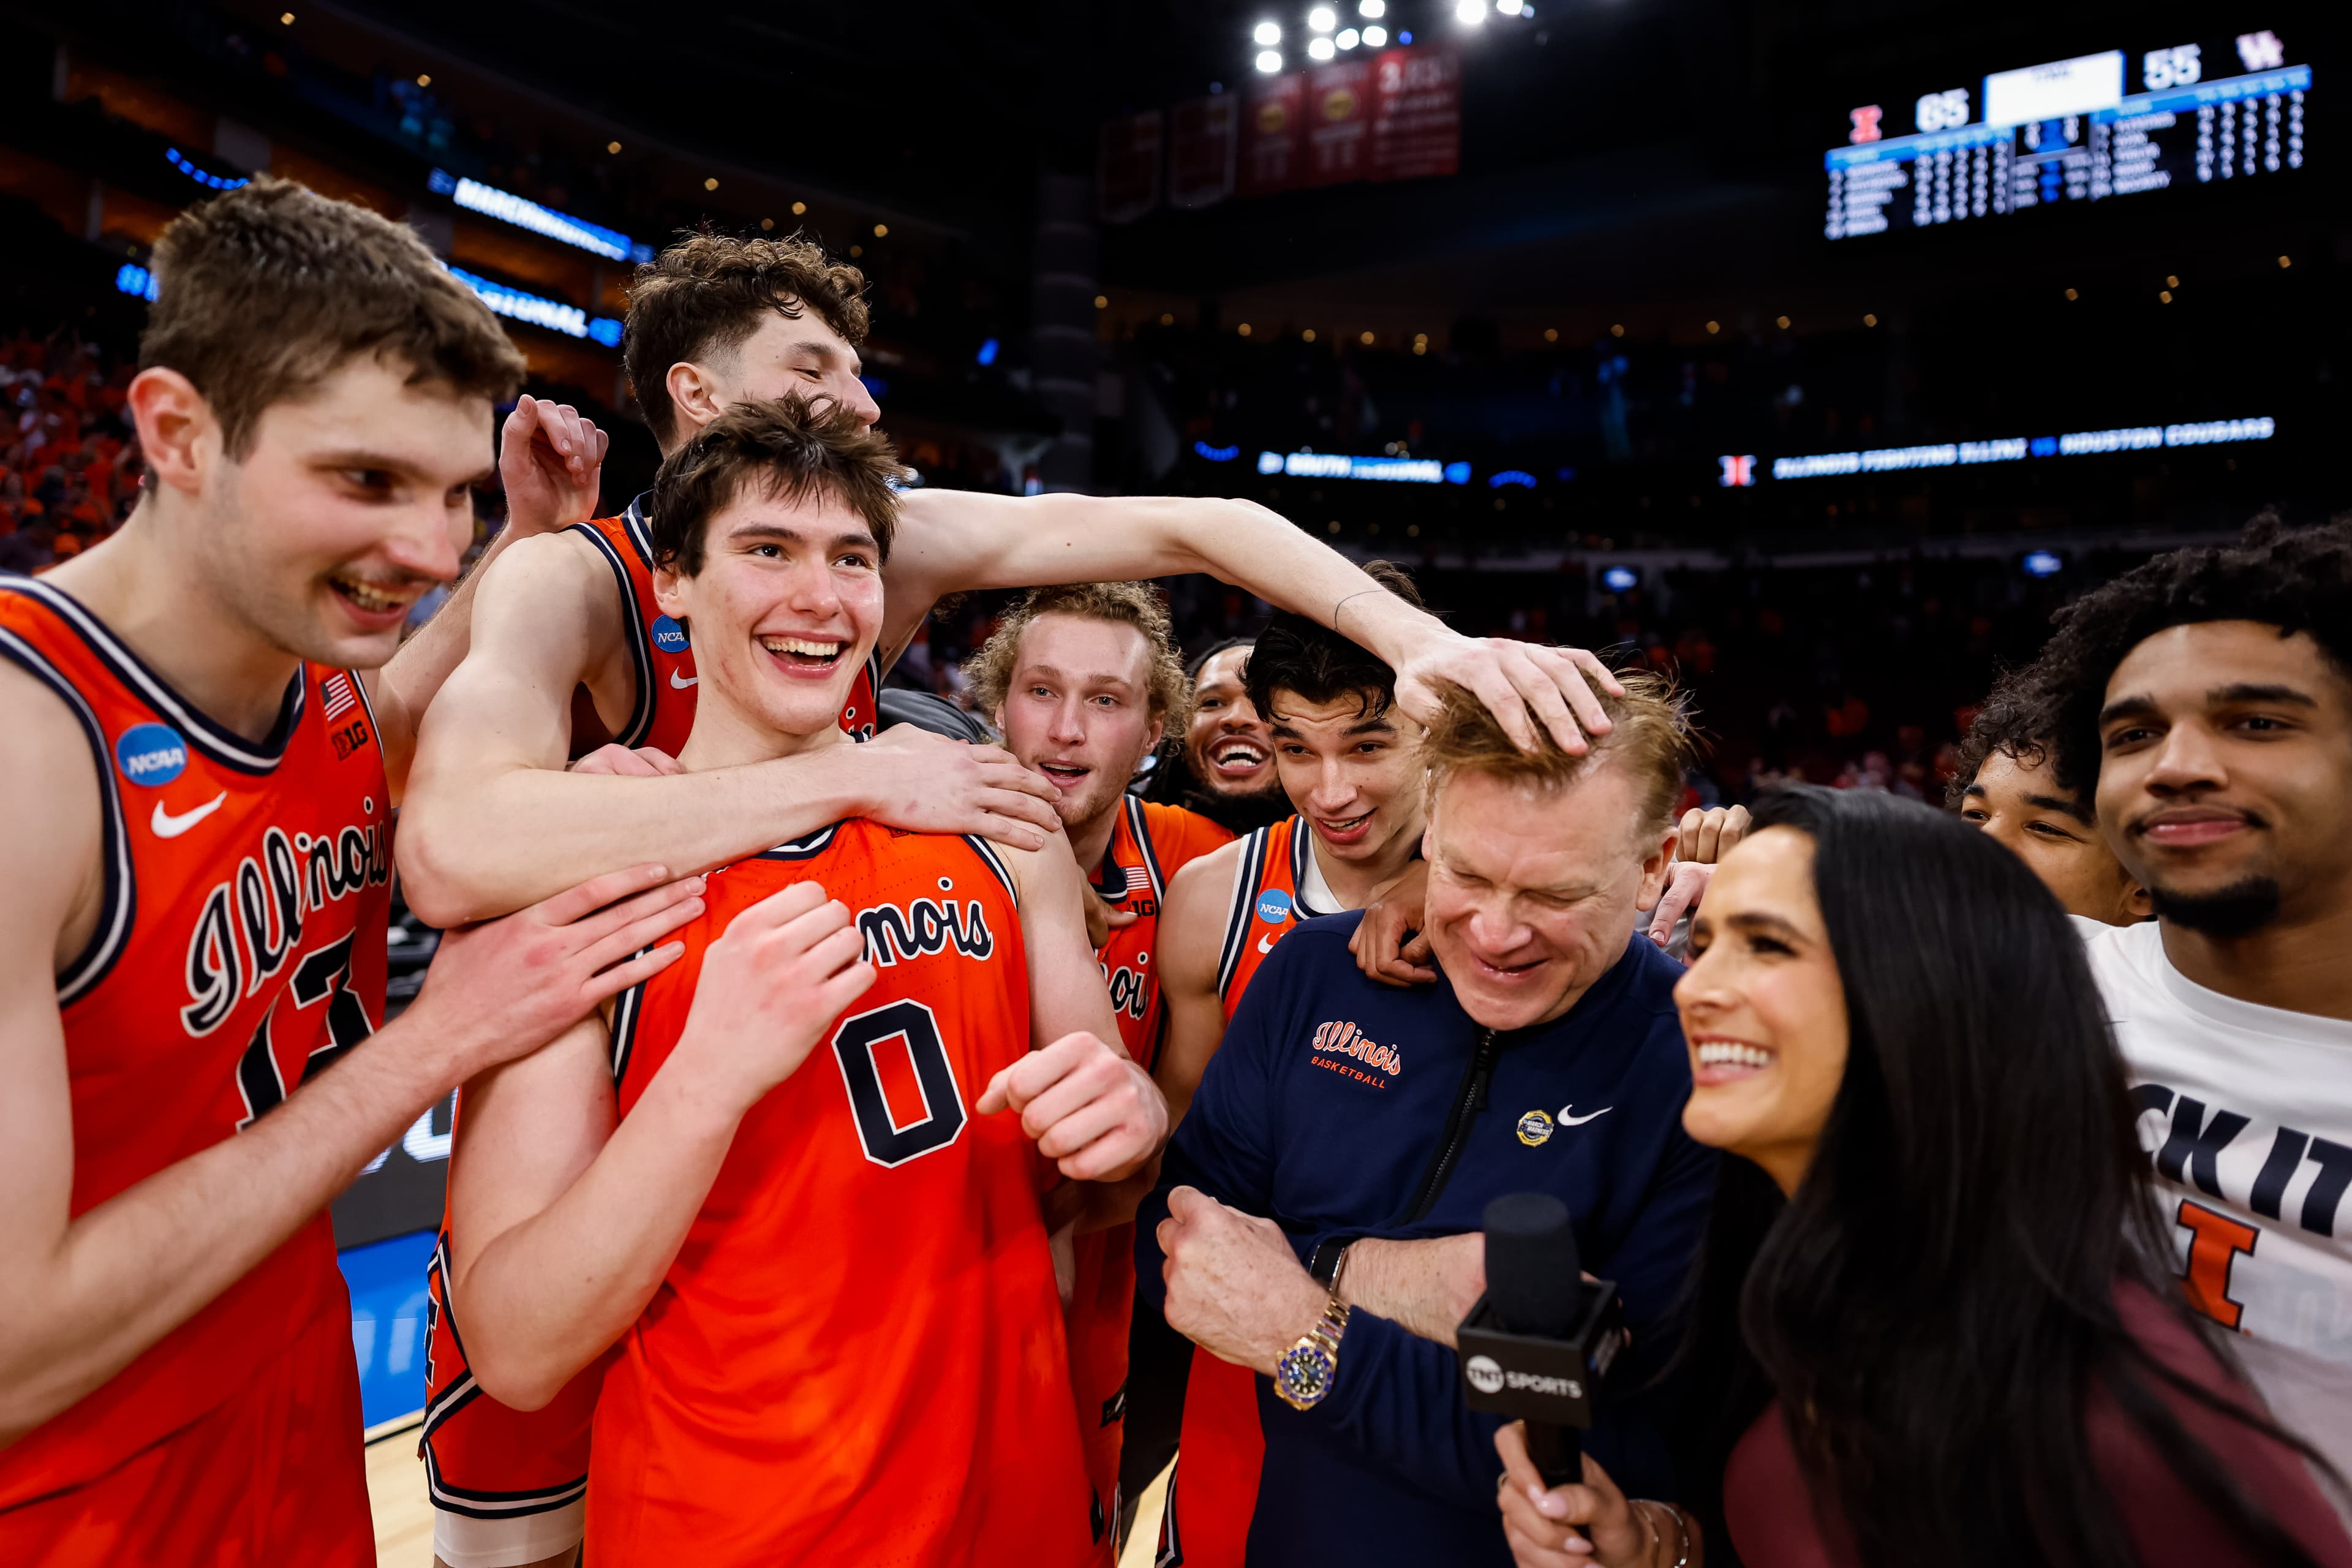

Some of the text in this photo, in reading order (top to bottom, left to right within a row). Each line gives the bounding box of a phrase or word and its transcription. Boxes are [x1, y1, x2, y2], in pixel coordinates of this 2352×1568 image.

[1915, 88, 1970, 133] 65
[2144, 43, 2201, 91] 55
[657, 631, 685, 643] NCA
[127, 748, 185, 776] NCAA
[180, 796, 388, 1038] Illinois
[855, 876, 994, 968] nois
[1260, 903, 1289, 916] NCAA
[1312, 1020, 1401, 1076] Illinois
[831, 997, 969, 1169] 0
[1311, 1056, 1385, 1088] BASKETBALL
[1506, 1370, 1582, 1398] SPORTS
